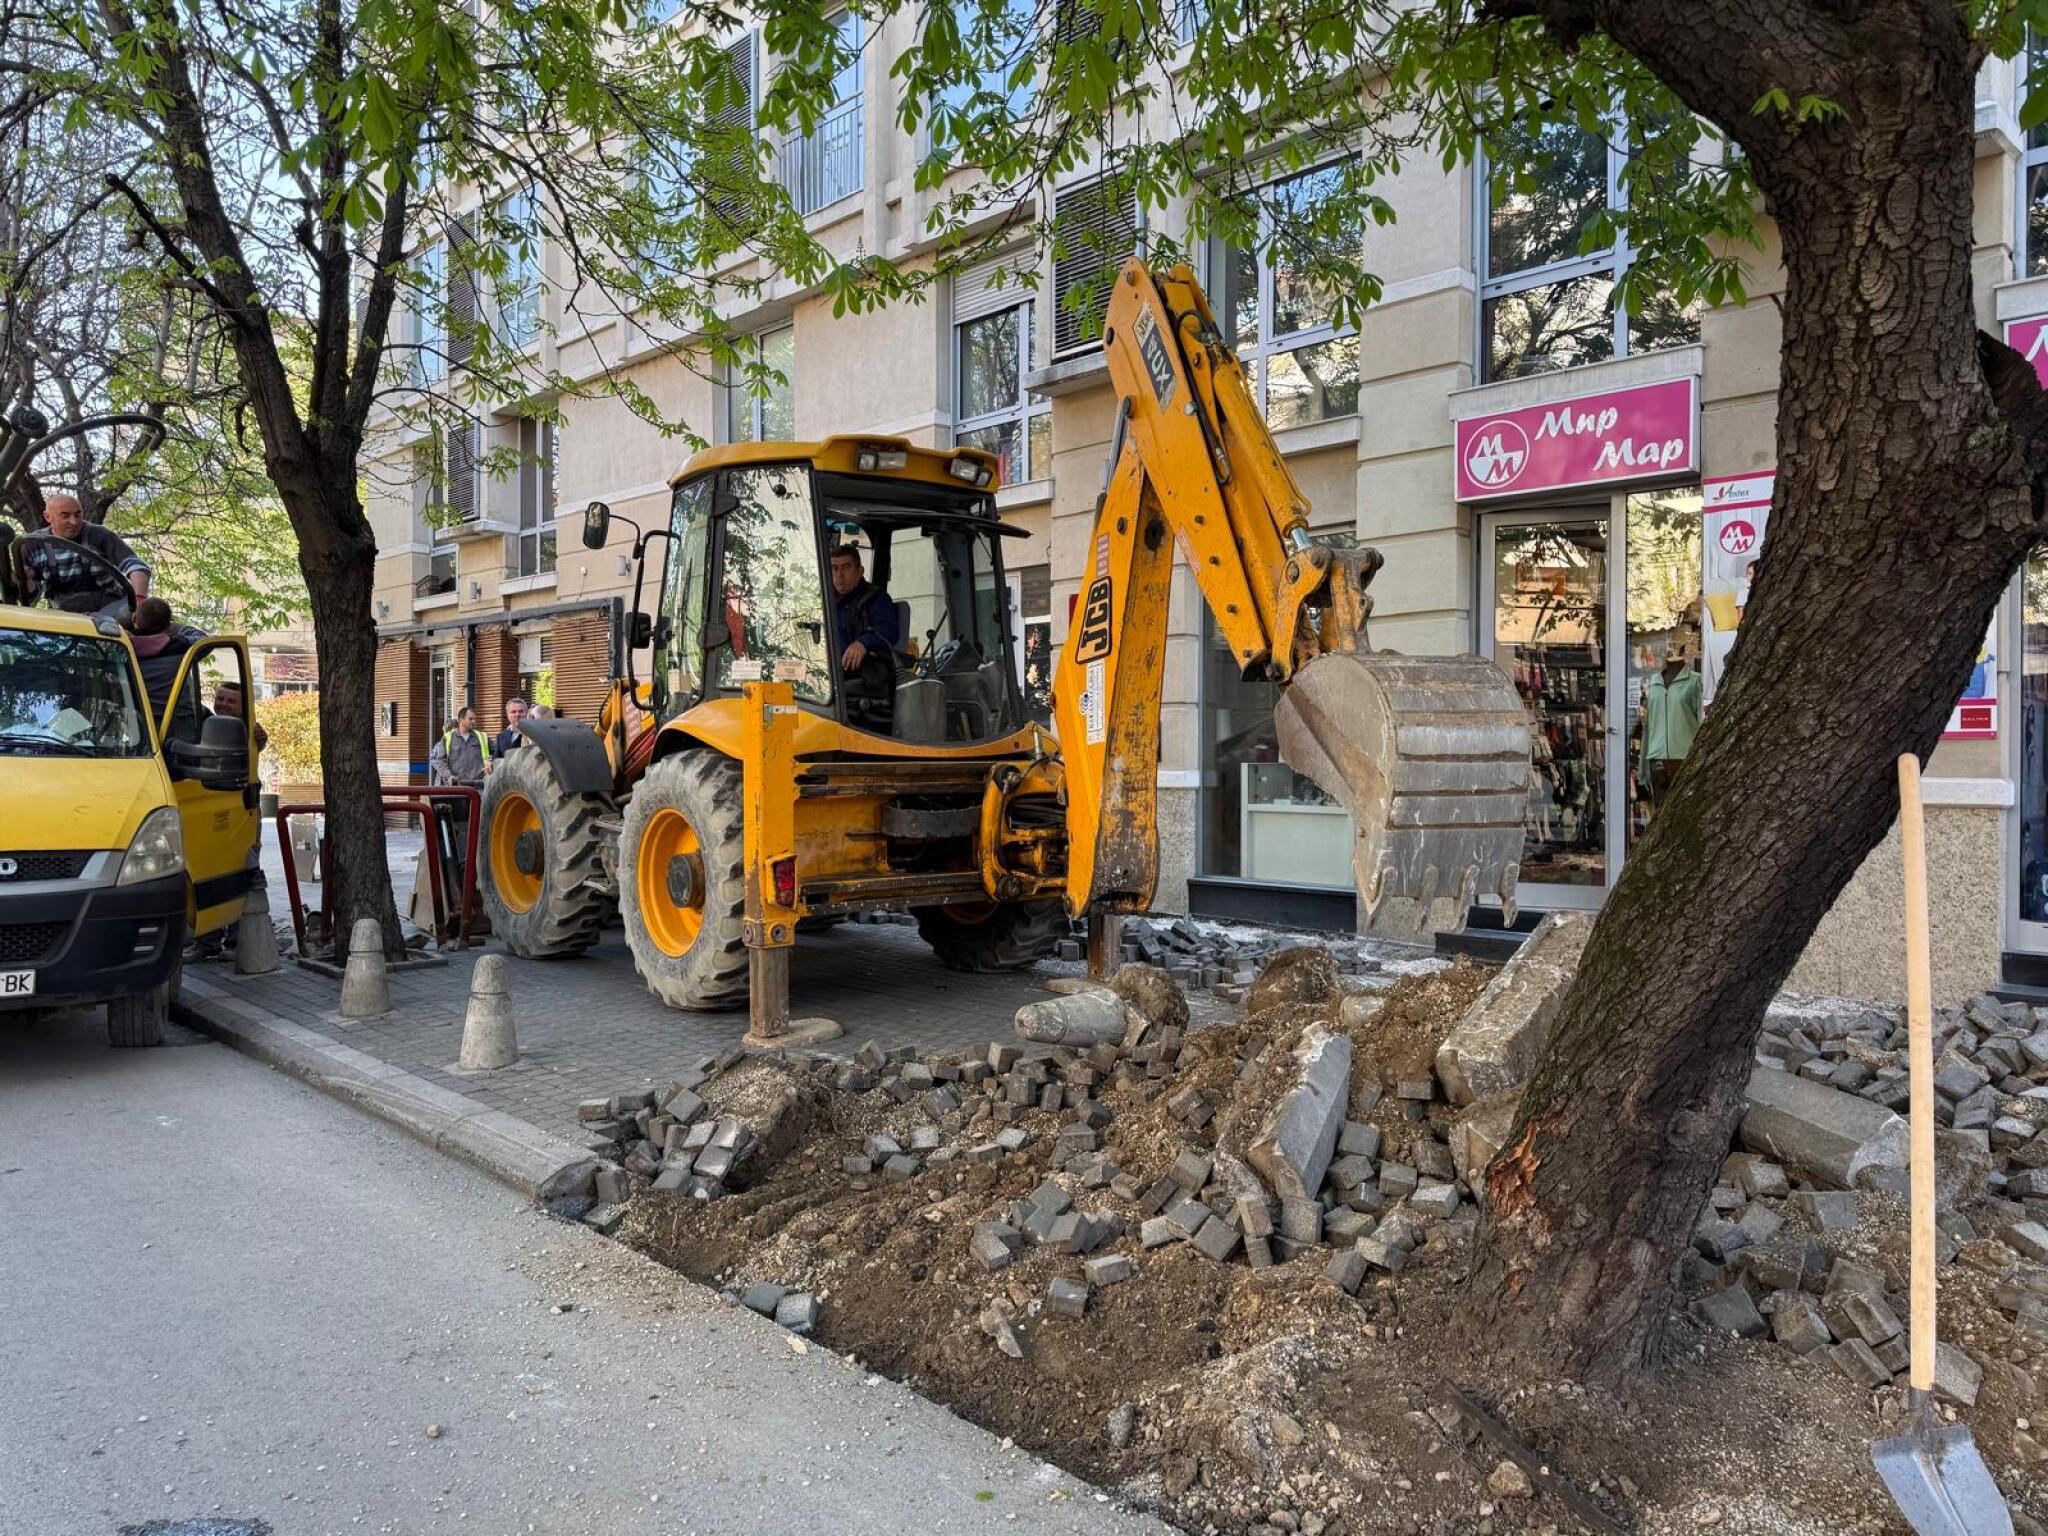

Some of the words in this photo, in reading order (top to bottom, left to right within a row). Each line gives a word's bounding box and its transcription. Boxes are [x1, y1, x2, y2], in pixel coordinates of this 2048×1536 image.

[1534, 406, 1619, 440] Мир
[1592, 437, 1684, 471] Мар
[1080, 582, 1109, 653] JCB
[5, 974, 31, 993] BK
